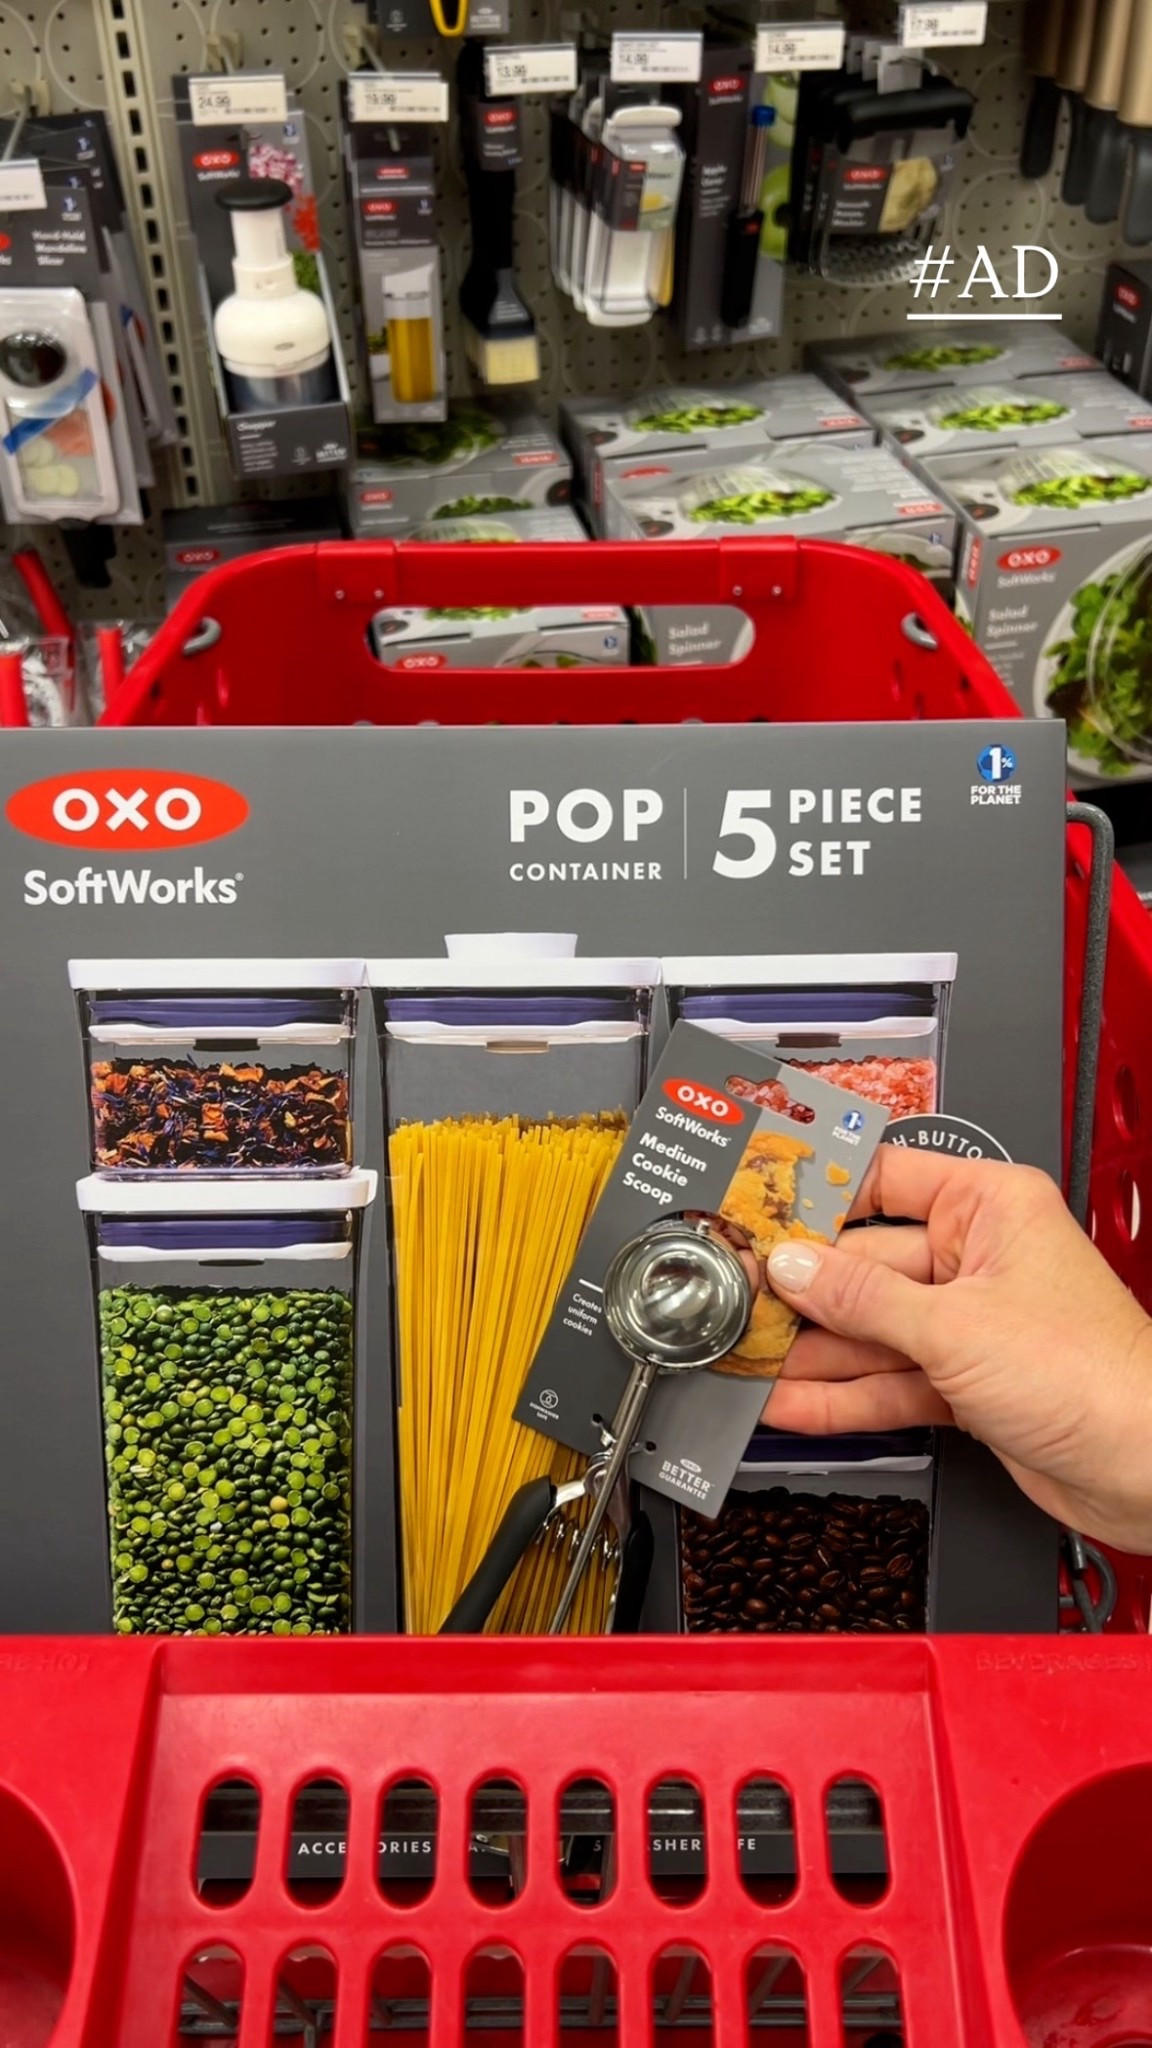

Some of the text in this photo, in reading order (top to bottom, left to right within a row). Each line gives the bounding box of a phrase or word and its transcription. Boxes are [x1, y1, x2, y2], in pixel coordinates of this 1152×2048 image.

[1007, 548, 1051, 568] OXO
[989, 605, 1029, 621] Salad
[668, 622, 709, 640] Salad
[986, 620, 1038, 638] Spinner
[668, 640, 722, 657] Spinner
[970, 784, 1022, 795] FOR THE
[970, 795, 1022, 805] PLANET
[52, 787, 202, 832] OXO
[509, 788, 664, 843] POP
[711, 787, 922, 879] 5 PIECE
[788, 840, 871, 877] SET
[509, 861, 663, 882] CONTAINER
[676, 1084, 730, 1118] OXO
[638, 1131, 708, 1173] Medium
[631, 1151, 689, 1187] Cookie
[622, 1170, 674, 1206] Scoop
[572, 1292, 603, 1314] Creates
[567, 1305, 598, 1326] uniform
[563, 1317, 593, 1337] cookies
[658, 1471, 708, 1500] GUARANTEE
[661, 1460, 712, 1493] BETTER
[298, 1841, 433, 1855] ACCEORIES
